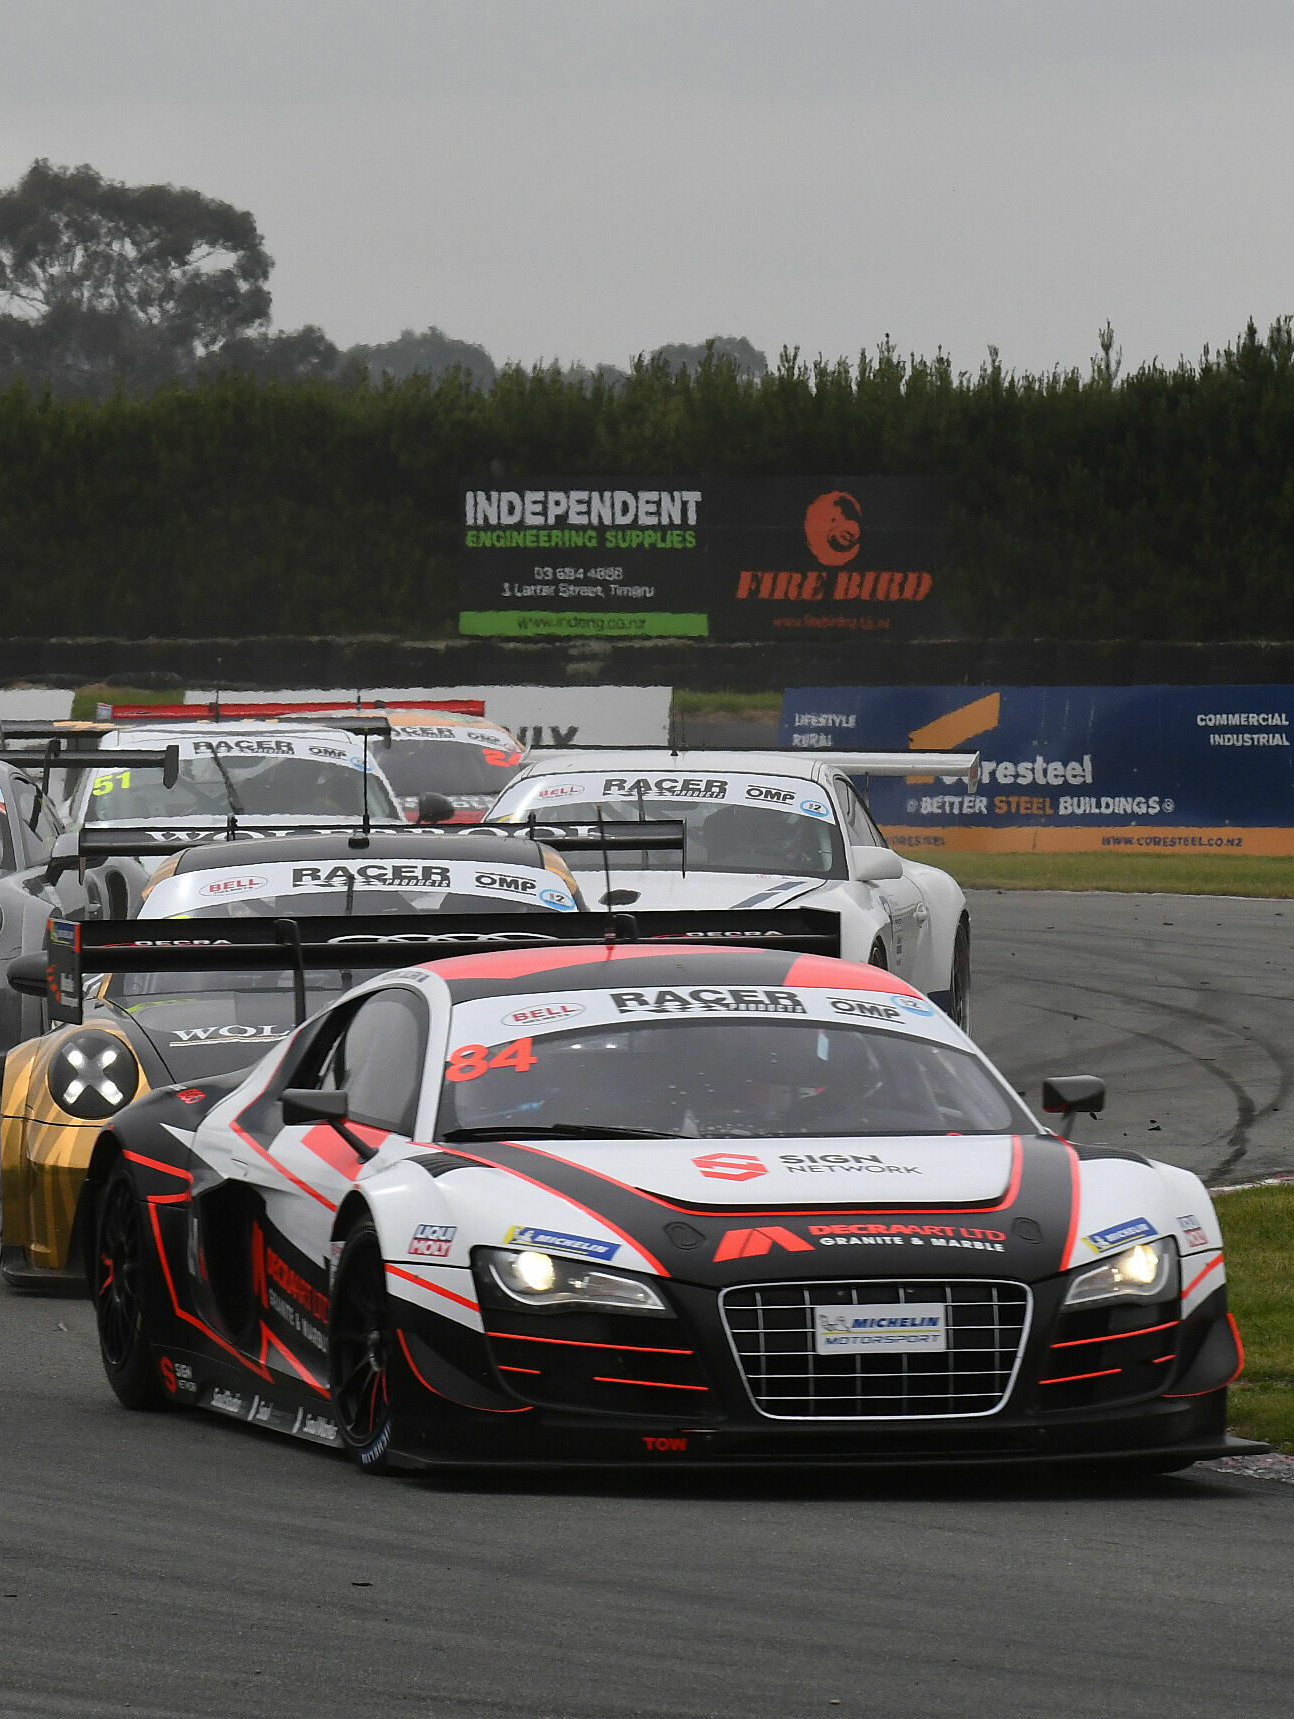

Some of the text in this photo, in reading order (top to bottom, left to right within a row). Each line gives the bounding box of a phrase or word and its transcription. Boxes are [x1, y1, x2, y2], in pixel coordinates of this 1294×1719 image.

[465, 490, 702, 526] INDEPENDENT
[465, 530, 696, 549] ENGINEERING SUPPLIES
[737, 571, 933, 601] FIRE BIRD
[1197, 714, 1289, 727] COMMERCIAL
[1210, 734, 1290, 748] INDUSTRIAL
[940, 755, 1092, 786] resteel
[93, 771, 131, 796] 51
[539, 786, 581, 798] BELL
[603, 778, 728, 796] RACER
[746, 787, 796, 801] OMP
[920, 796, 1160, 815] BETTER STEEL BUILDINGS
[209, 878, 258, 893] BELL
[293, 865, 450, 884] RACER
[475, 875, 536, 892] OMP
[386, 879, 449, 887] PRODUCTS
[512, 1004, 576, 1021] BELL
[610, 989, 804, 1009] RACER
[831, 1000, 903, 1019] OMP
[729, 1003, 804, 1013] PRODUCTS
[445, 1037, 538, 1082] 84
[778, 1154, 884, 1164] SIGN
[786, 1165, 924, 1175] NETWORK
[808, 1224, 1006, 1241] DECRAART LTD
[409, 1240, 450, 1256] MOLY
[534, 1235, 609, 1253] MICHELIN
[819, 1236, 1005, 1252] GRANITE & MARBLE
[851, 1316, 940, 1329] MICHELIN
[824, 1334, 940, 1346] MOTORSPORT
[644, 1437, 687, 1452] TOW
